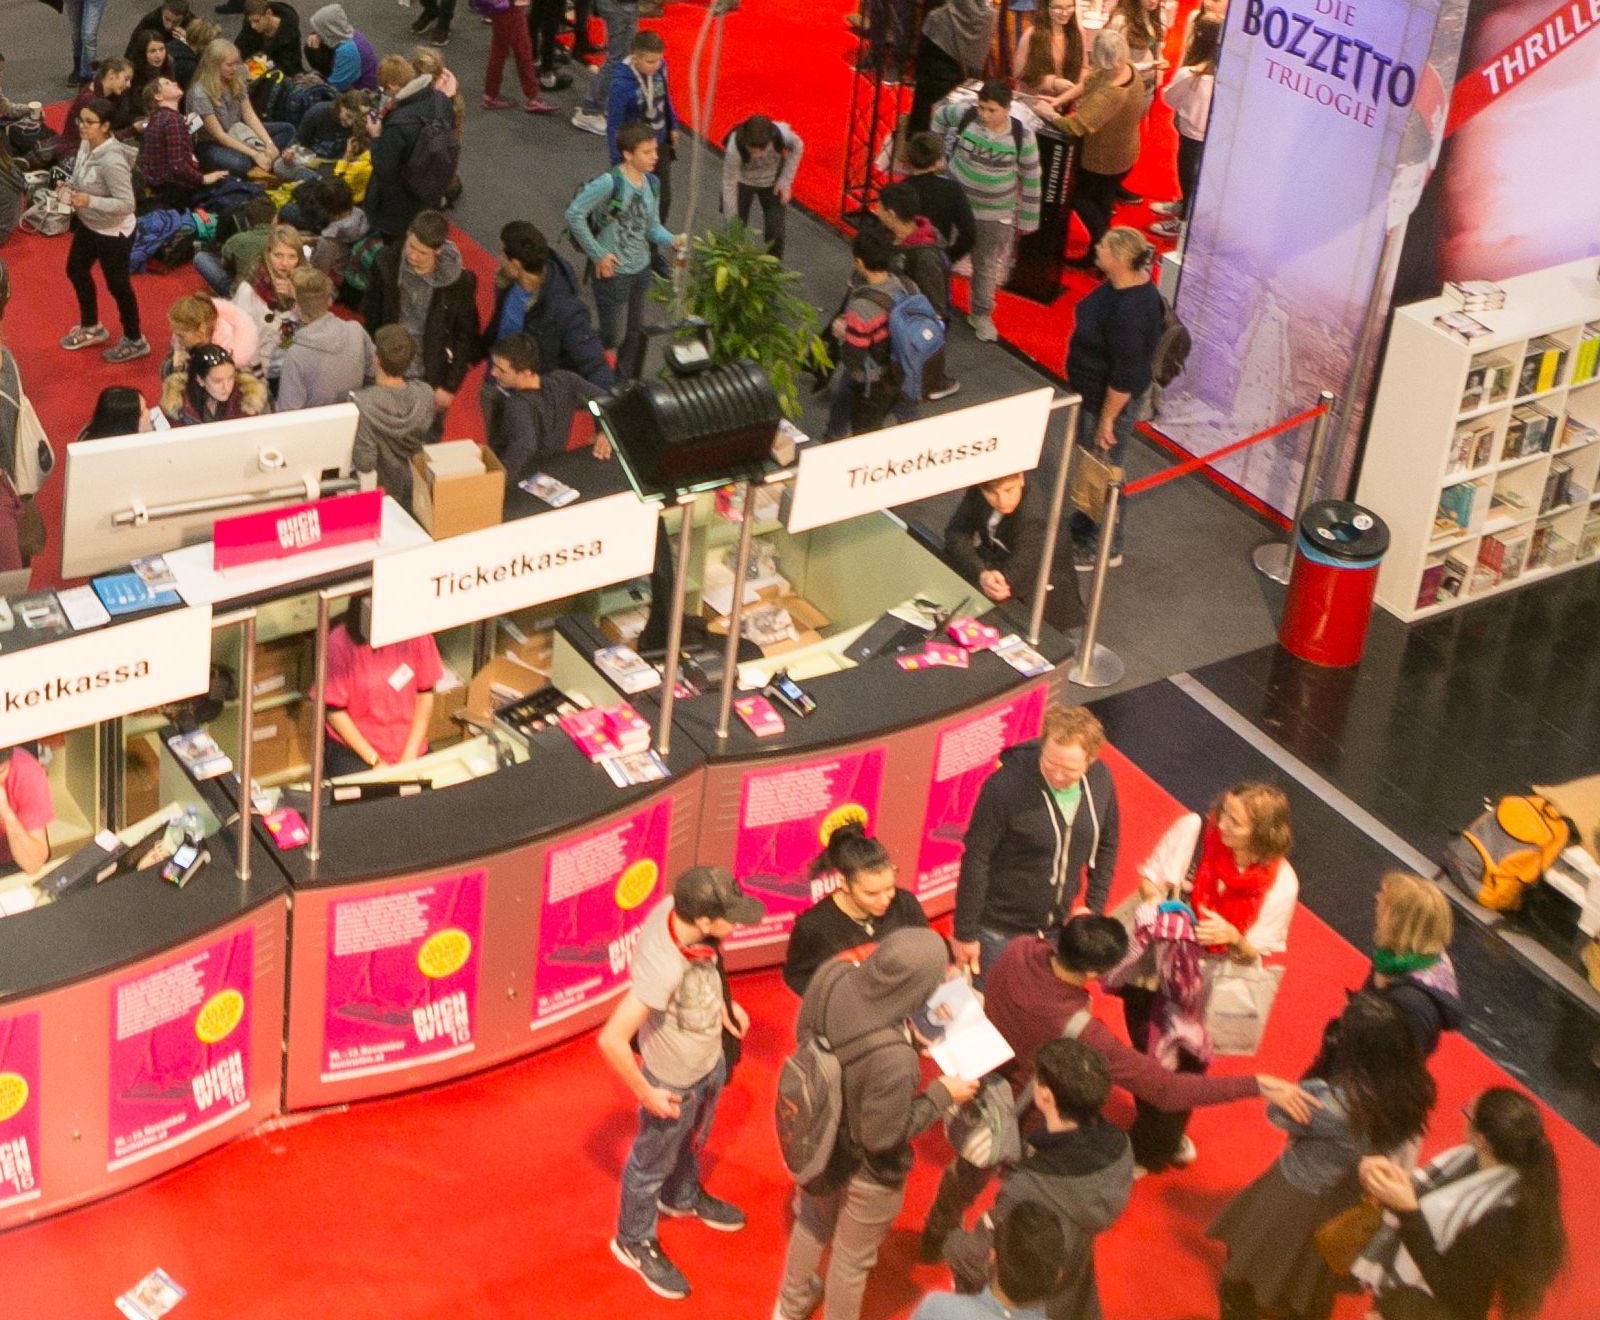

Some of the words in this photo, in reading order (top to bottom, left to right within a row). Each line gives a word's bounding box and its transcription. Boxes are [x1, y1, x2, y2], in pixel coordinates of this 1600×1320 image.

[1265, 58, 1377, 129] TRILOGIE
[847, 434, 1000, 489] Ticketkassa
[276, 509, 320, 536] BUCH
[279, 523, 321, 549] WIEN
[430, 537, 604, 598] Ticketkassa
[412, 991, 468, 1027] BUCH
[416, 1012, 469, 1043] WIEN
[192, 1050, 243, 1091] BUCH
[196, 1070, 245, 1111] WIEN
